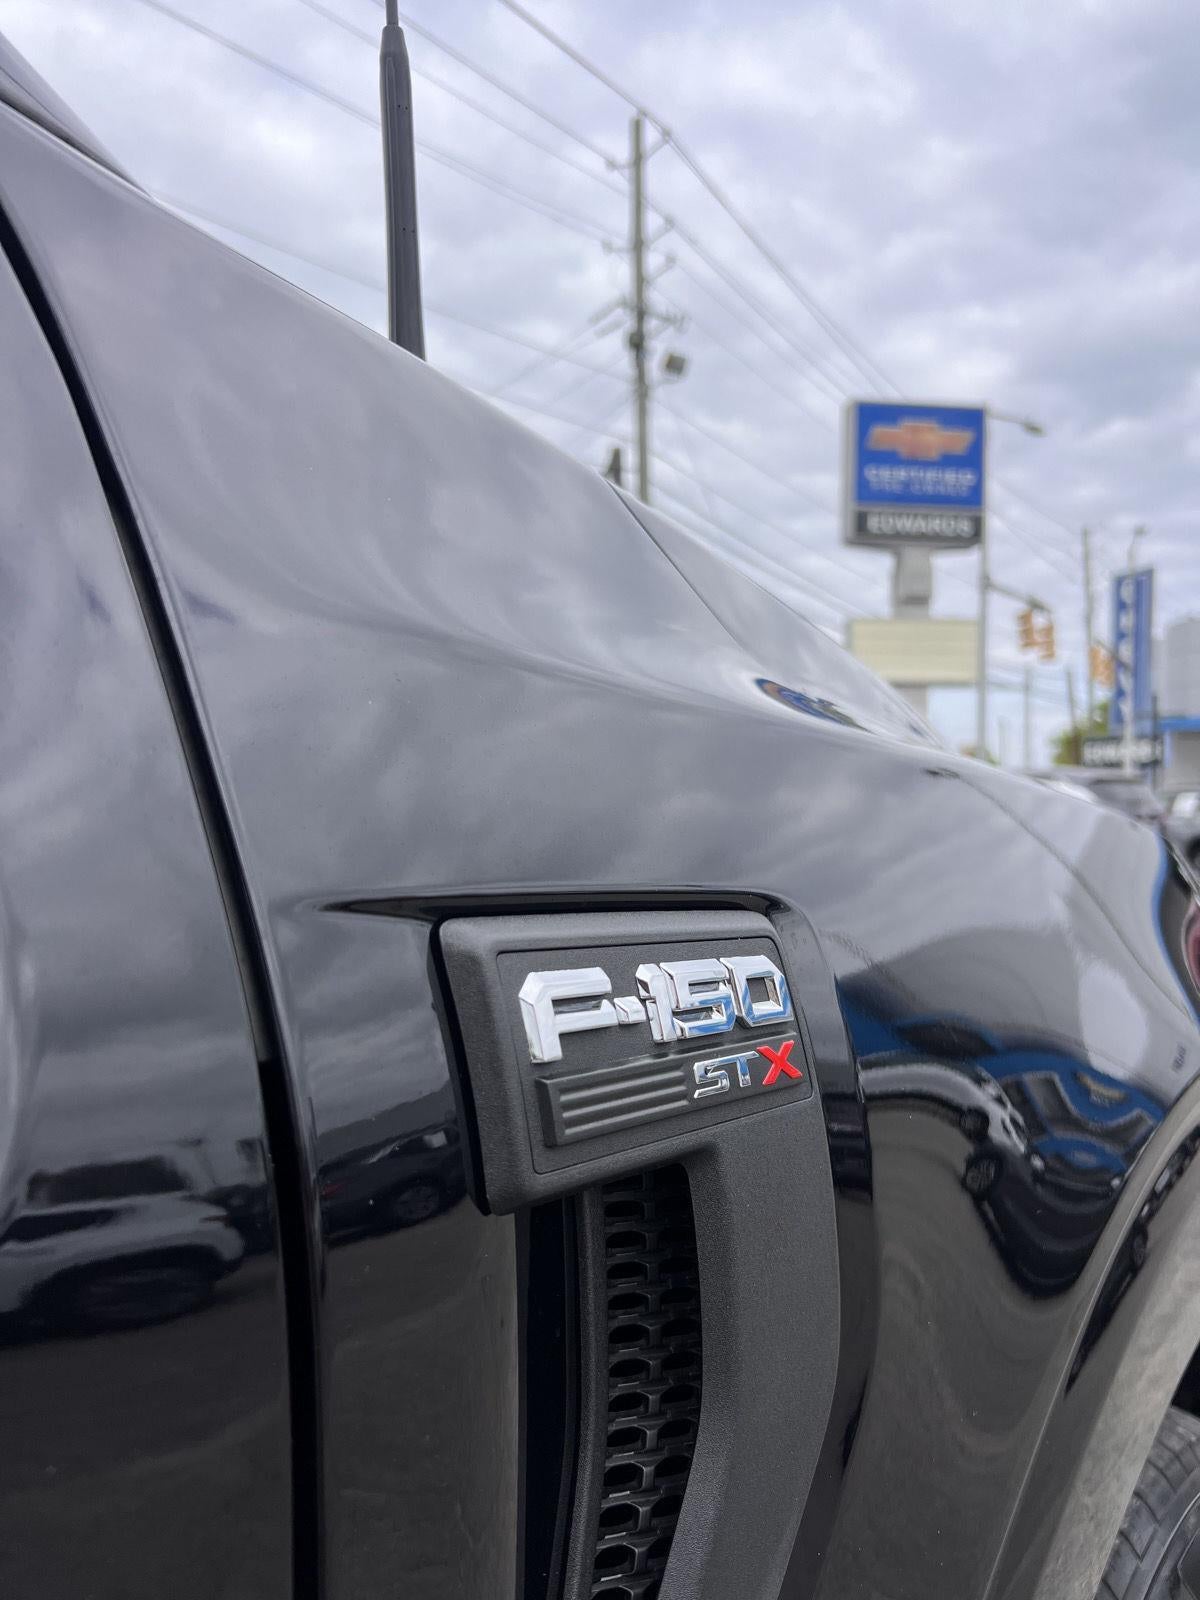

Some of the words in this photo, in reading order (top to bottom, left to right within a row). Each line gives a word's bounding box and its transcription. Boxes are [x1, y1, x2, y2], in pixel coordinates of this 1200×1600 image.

[867, 512, 976, 538] EDWARDS
[518, 954, 795, 1064] F-150
[693, 1040, 803, 1099] STX
